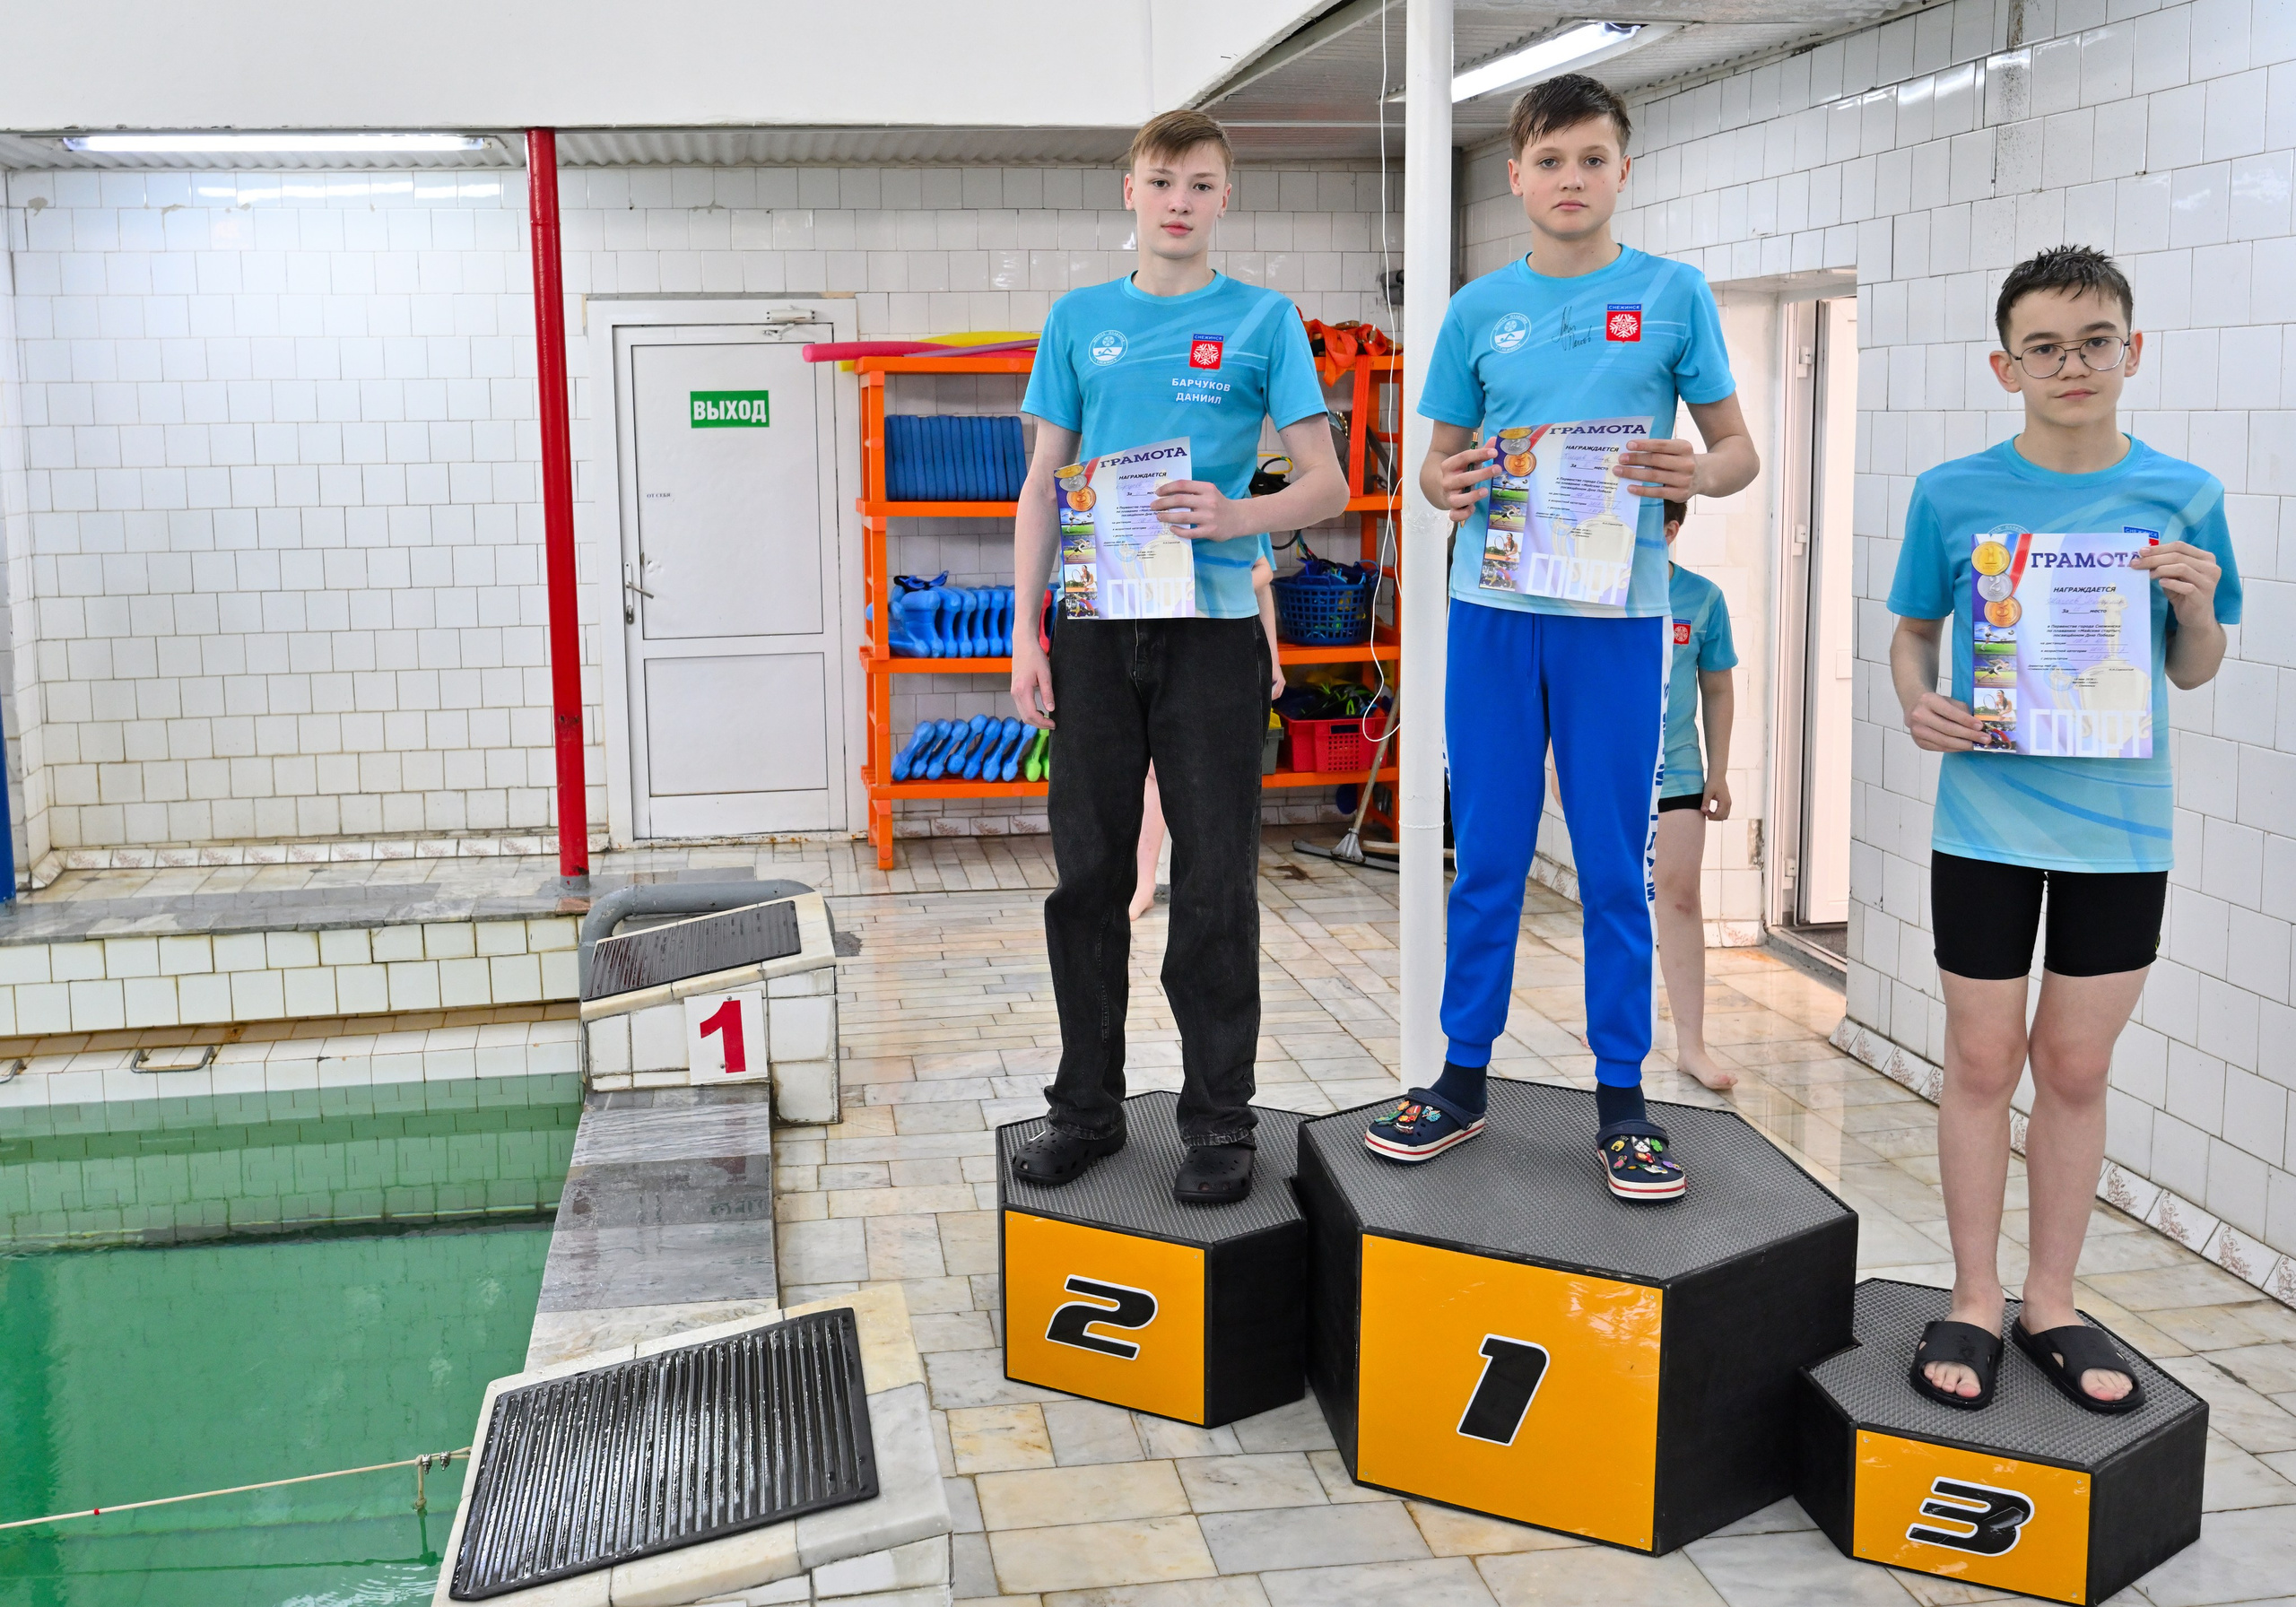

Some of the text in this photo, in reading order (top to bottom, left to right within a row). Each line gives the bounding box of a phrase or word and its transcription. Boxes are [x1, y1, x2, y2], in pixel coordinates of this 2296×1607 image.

[1171, 378, 1231, 392] БАРЧУКОВ
[1176, 392, 1222, 404] ДАНИИЛ
[693, 400, 767, 423] ВЫХОД
[1549, 424, 1647, 435] ГРАМОТА
[1100, 447, 1187, 468] ГРАМОТА
[1565, 445, 1620, 453] НАГРАЖДАЕТСЯ
[1118, 472, 1167, 480] НАГРАЖДАЕТСЯ
[1526, 552, 1628, 605] СПОРТ
[1106, 577, 1191, 619] СПОРТ
[2030, 708, 2147, 758] СПОРТ
[700, 1000, 746, 1073] 1
[1045, 1274, 1159, 1360] 2
[1456, 1333, 1551, 1446] 1
[1905, 1476, 2035, 1557] 3
